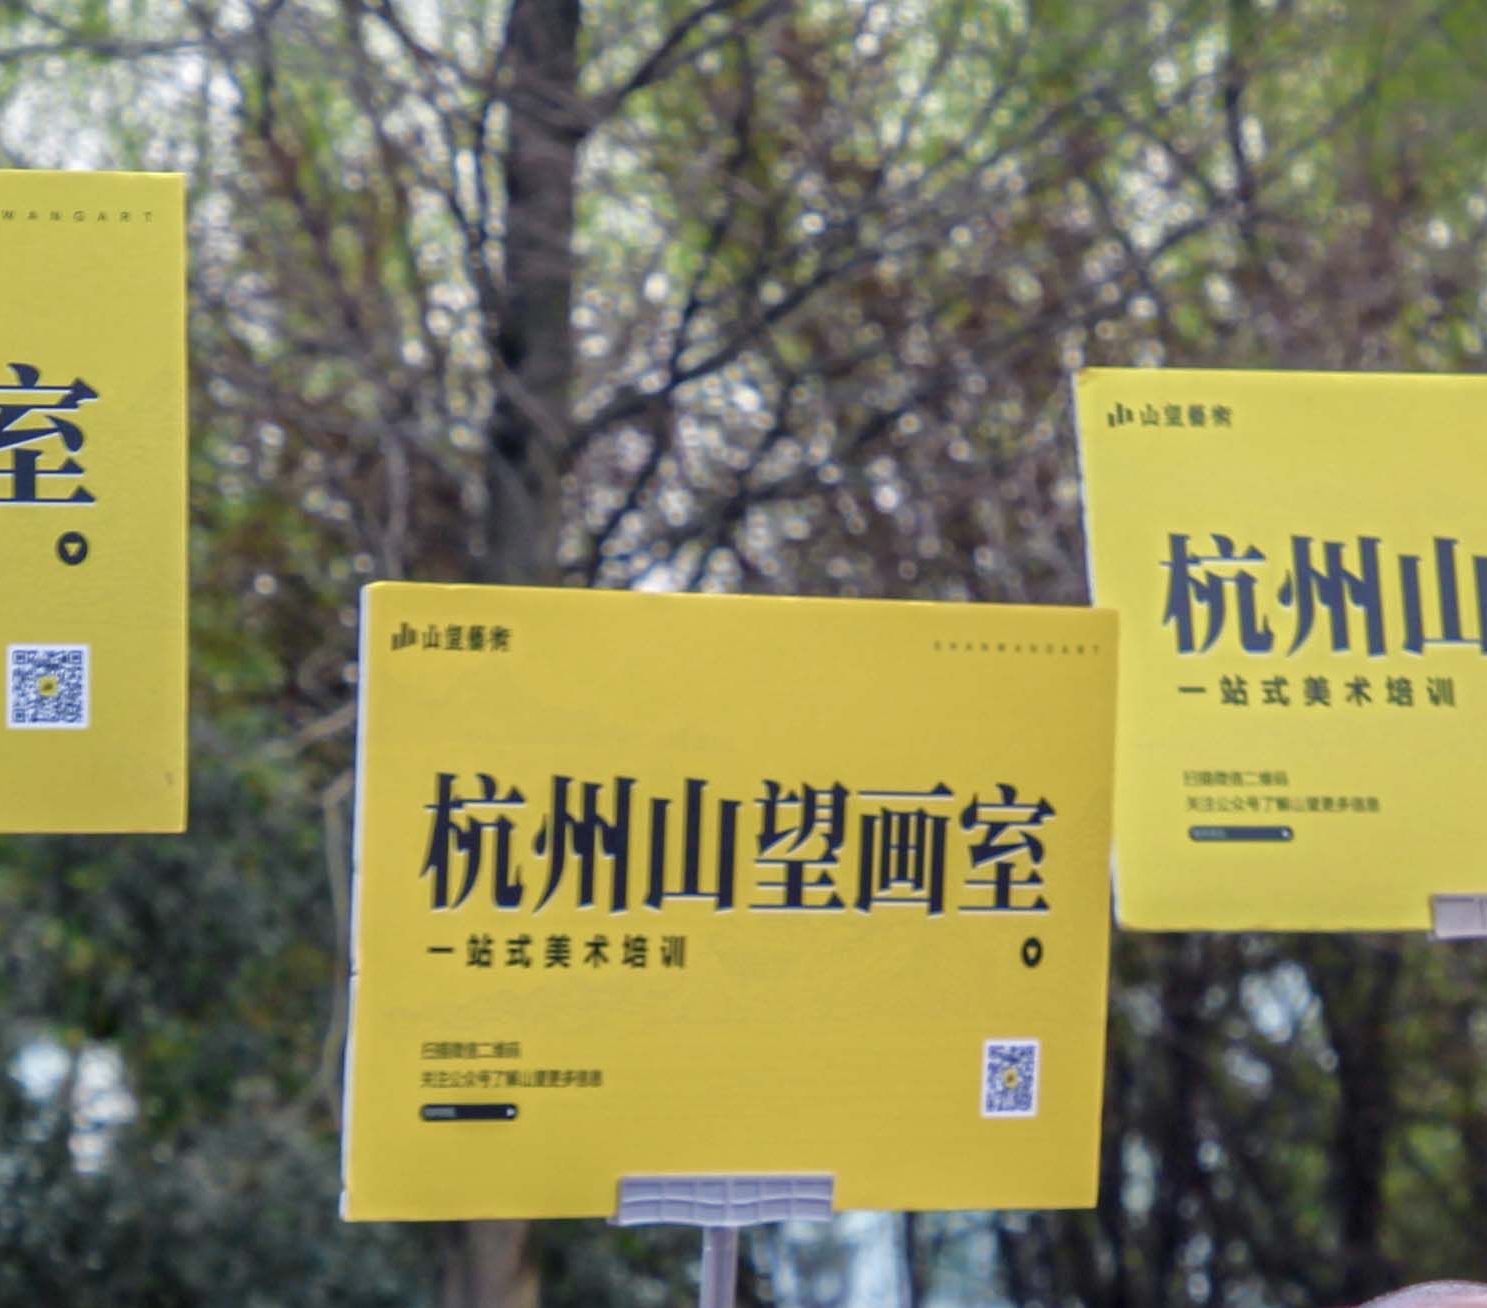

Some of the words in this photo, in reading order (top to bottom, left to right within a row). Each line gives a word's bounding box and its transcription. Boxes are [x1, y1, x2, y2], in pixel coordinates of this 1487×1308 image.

[1177, 675, 1457, 708] 一站式美术培训
[420, 772, 1057, 915] 杭州山望画室
[427, 934, 687, 969] 一站式美术培训
